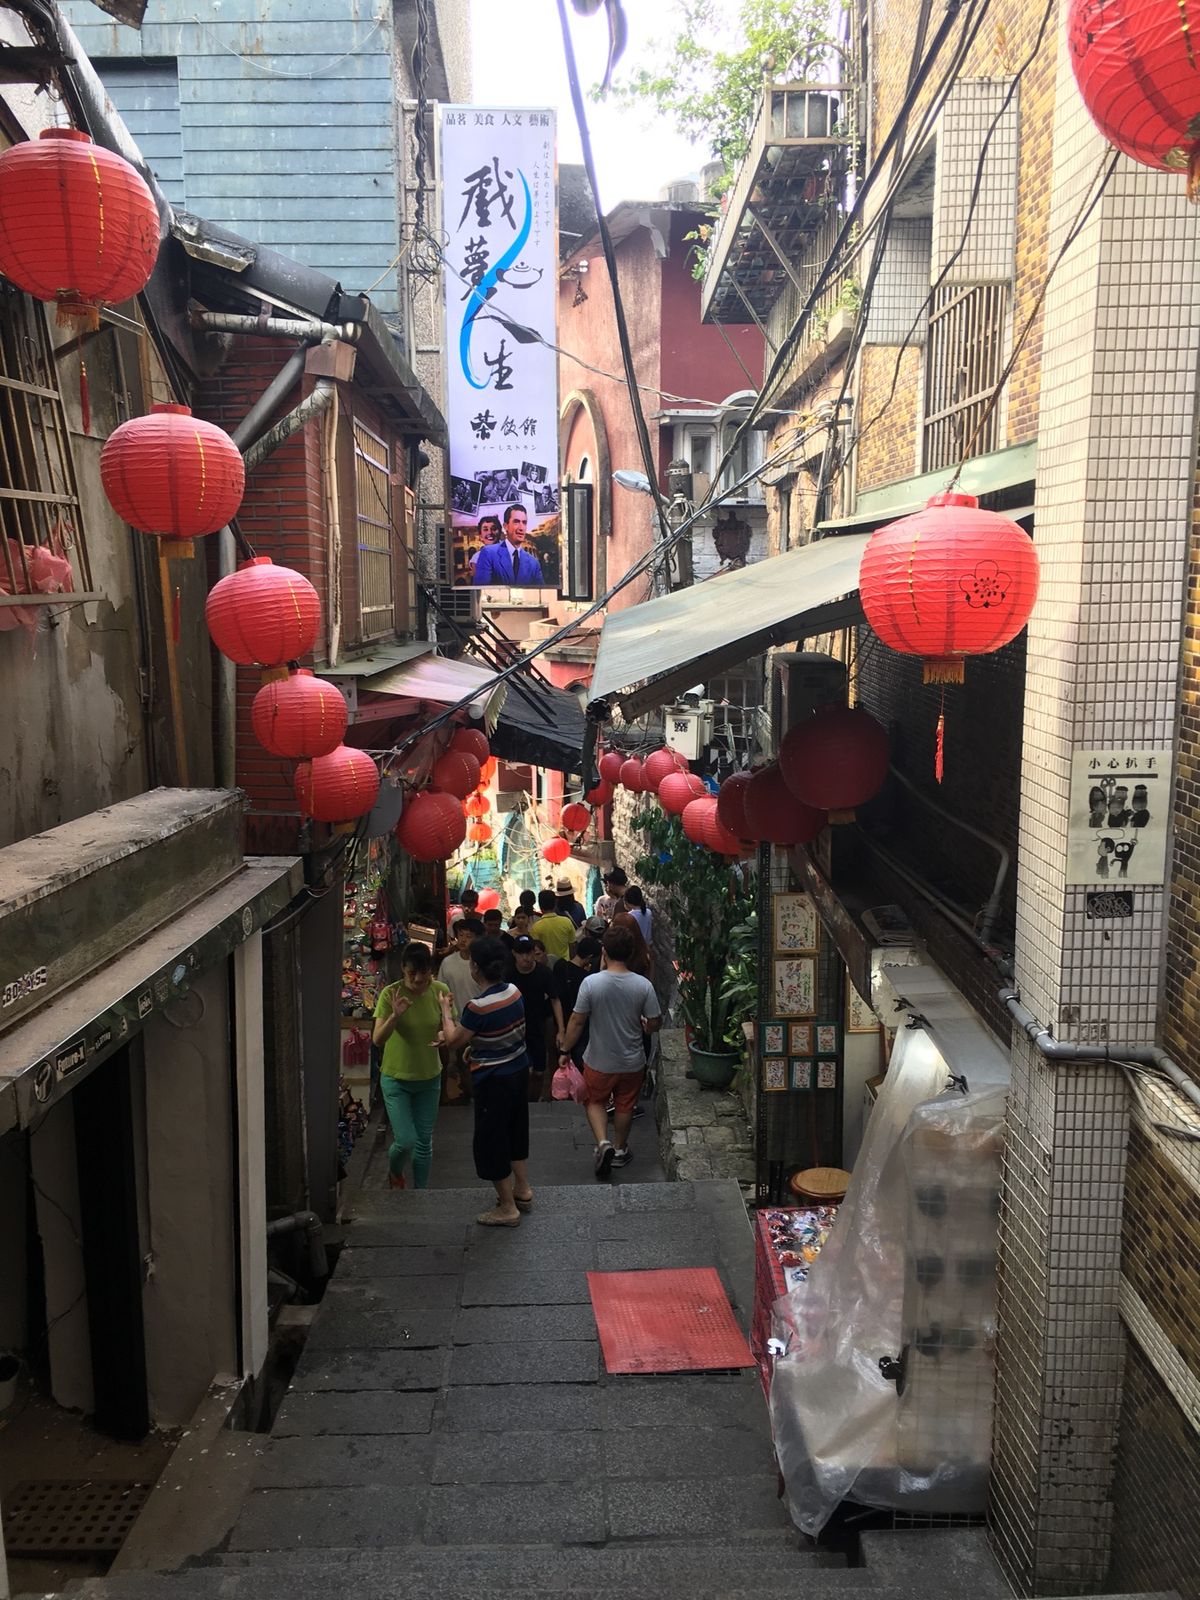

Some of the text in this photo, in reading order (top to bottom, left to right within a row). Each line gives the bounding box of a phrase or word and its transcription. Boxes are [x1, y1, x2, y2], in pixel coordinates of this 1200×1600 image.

[446, 113, 550, 127] 品茗 美食 人文 藝術
[1088, 756, 1158, 770] 小心扒手
